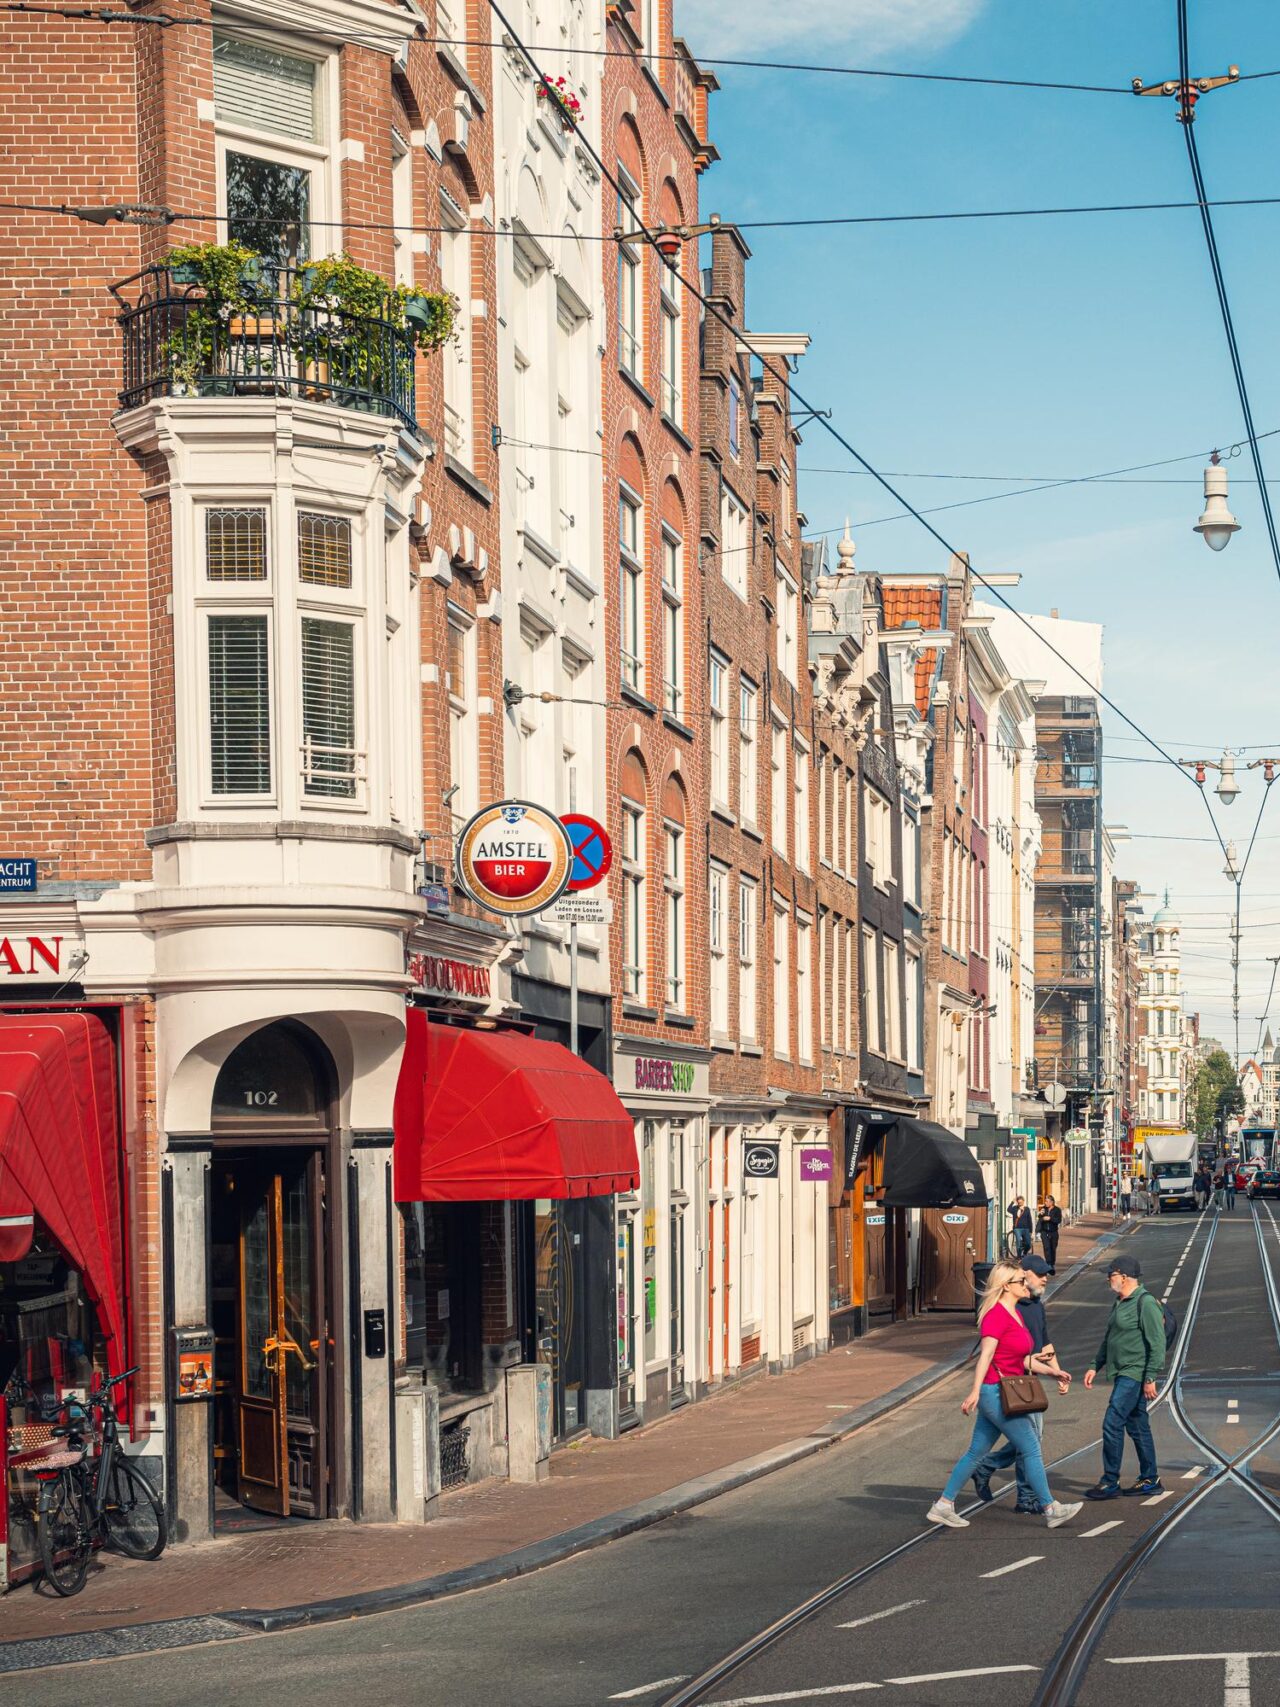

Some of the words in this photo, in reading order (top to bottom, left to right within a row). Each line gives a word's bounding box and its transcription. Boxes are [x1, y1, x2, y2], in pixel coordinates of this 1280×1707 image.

[477, 842, 547, 858] AMSTEL
[495, 864, 525, 876] BIER
[0, 937, 63, 975] AN
[635, 1057, 694, 1093] BARBERSHOP
[244, 1091, 278, 1105] 102
